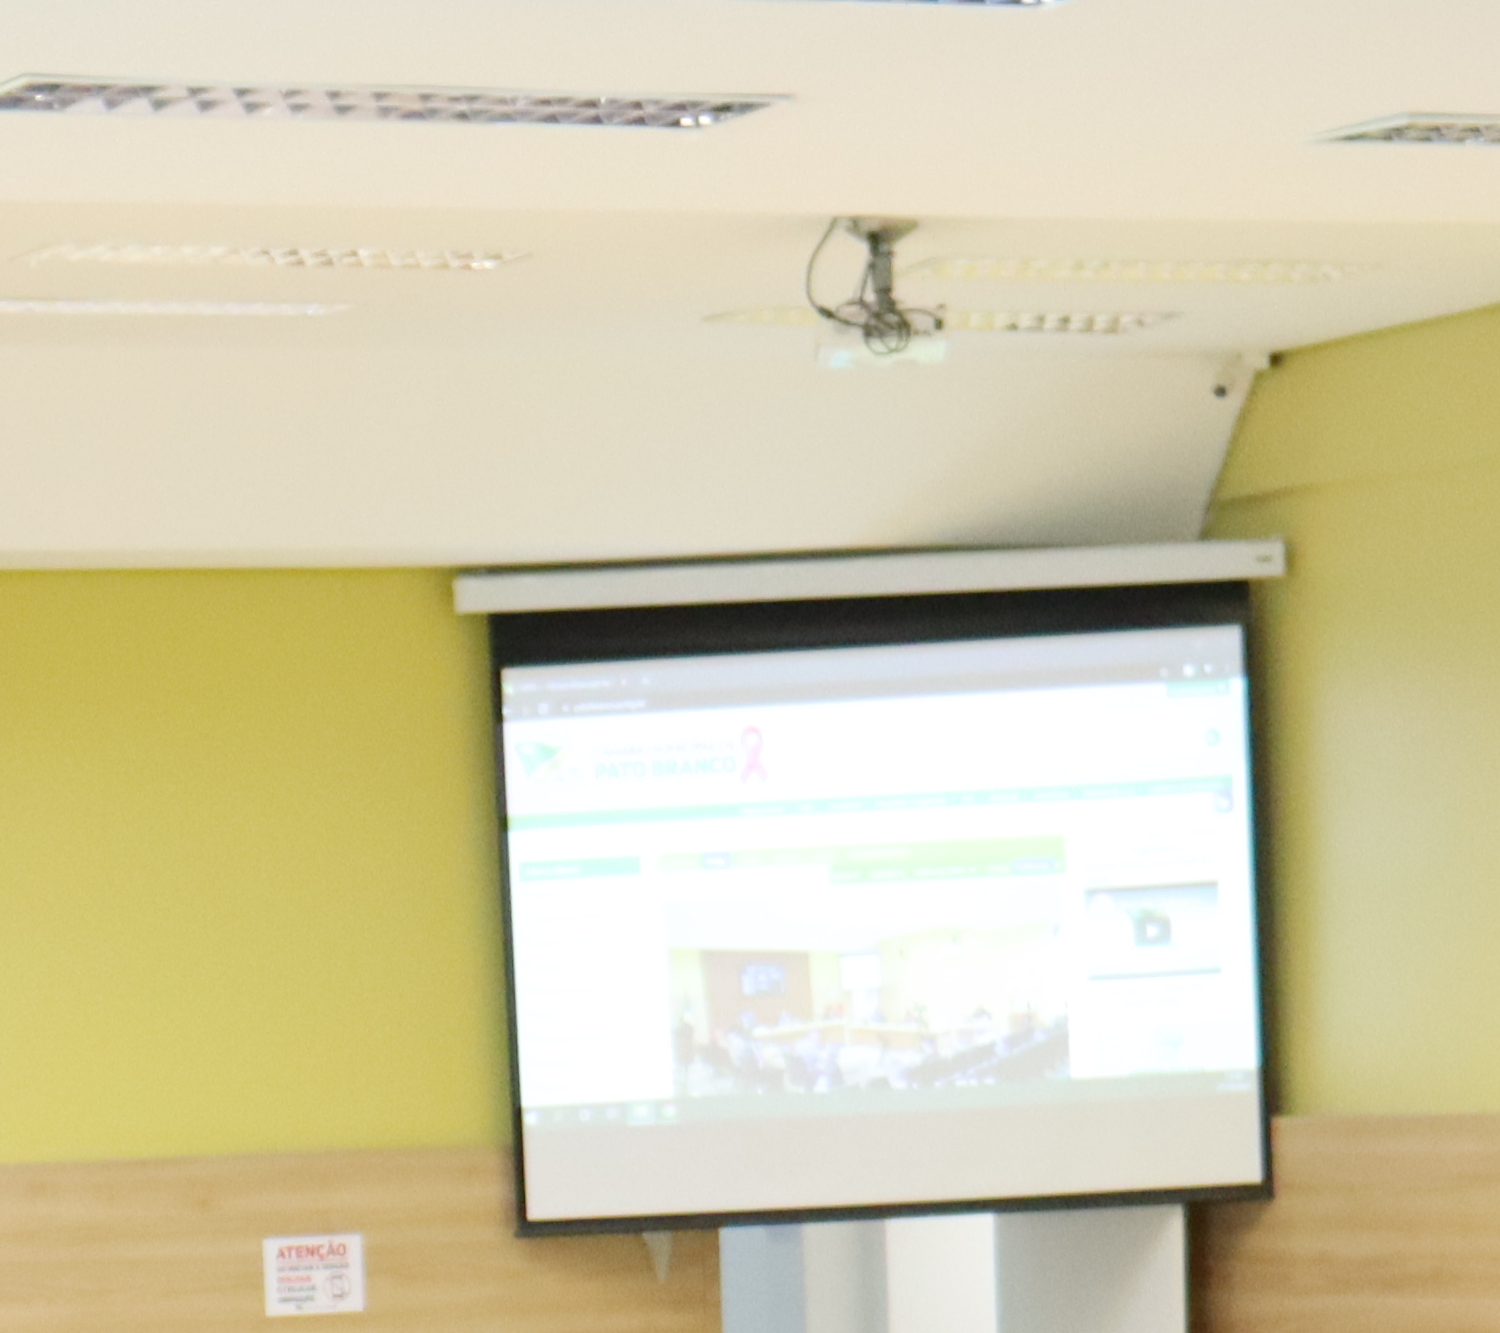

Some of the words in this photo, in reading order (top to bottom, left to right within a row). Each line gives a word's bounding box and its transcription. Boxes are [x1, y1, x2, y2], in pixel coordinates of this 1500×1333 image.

[595, 760, 646, 779] PATO
[651, 755, 737, 777] BRANCO
[276, 1240, 347, 1261] ATENÇÃO
